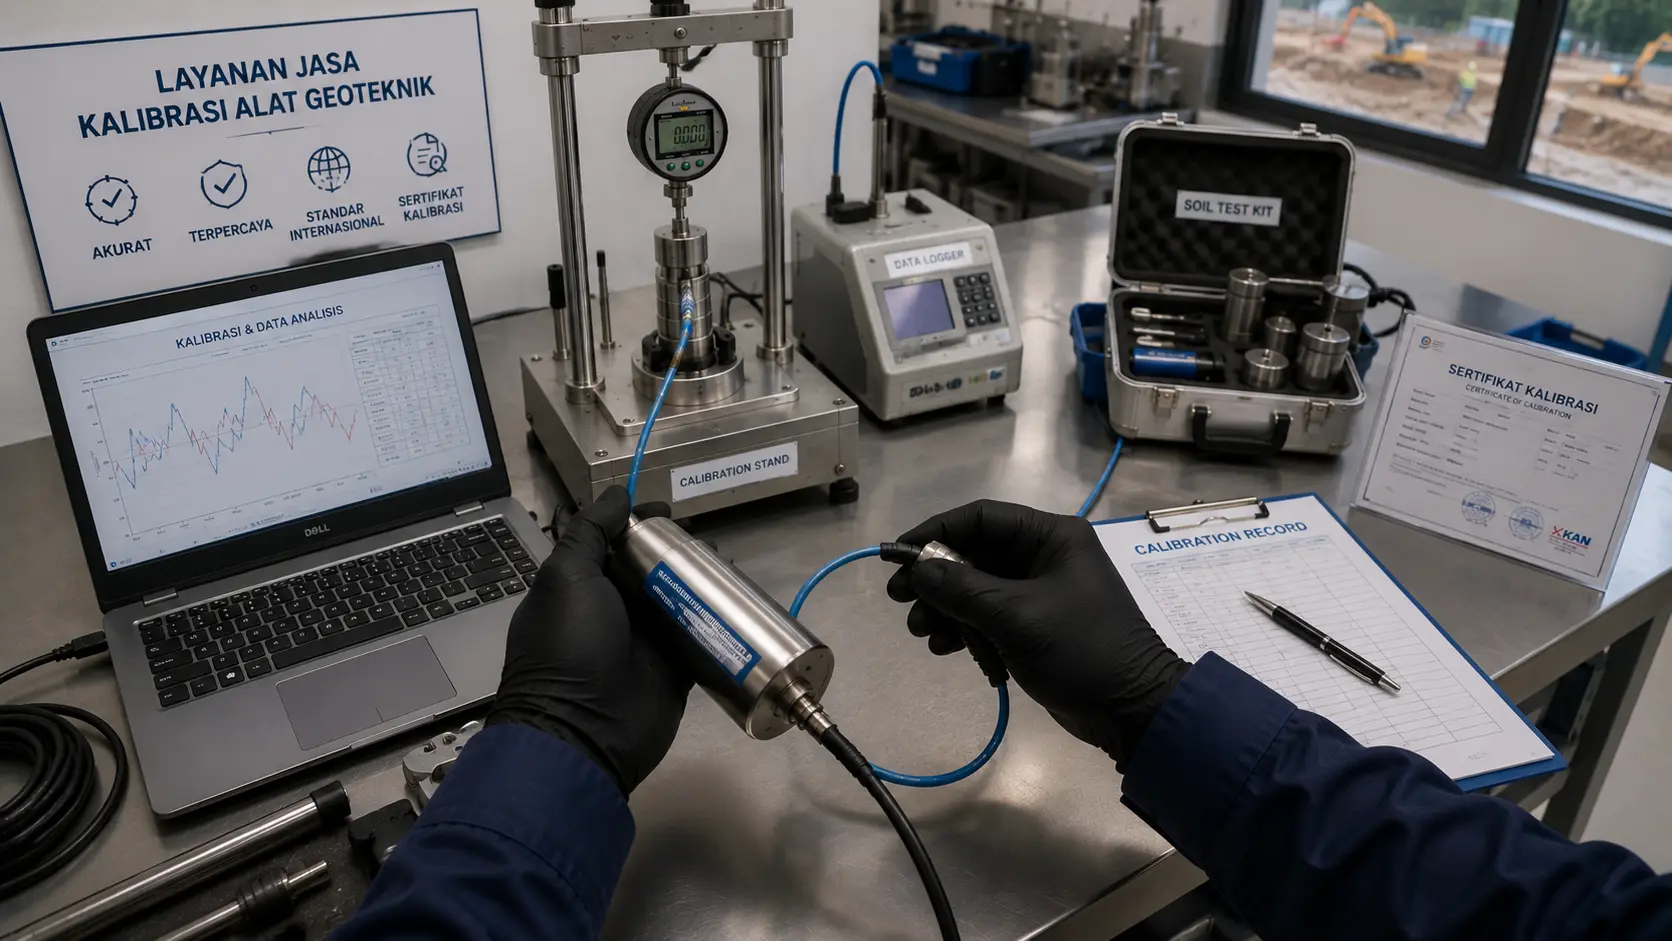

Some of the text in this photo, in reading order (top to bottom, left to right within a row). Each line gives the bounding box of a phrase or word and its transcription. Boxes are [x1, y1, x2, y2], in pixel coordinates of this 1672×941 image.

[155, 51, 360, 93] LAYANAN JASA
[78, 75, 435, 139] KALIBRASI ALAT GEOTEKNIK
[398, 187, 463, 206] SERTIFIKAT
[306, 203, 364, 222] STANDAR
[403, 203, 463, 221] KALIBRASI
[1184, 199, 1274, 218] SOIL TEST KIT
[189, 218, 273, 242] TERPERCAYA
[290, 216, 384, 241] INTERNASIONAL
[92, 238, 151, 259] AKURAT
[894, 250, 964, 270] DATA LOGGER
[176, 327, 241, 349] KALIBRASI
[245, 324, 254, 335] &
[256, 316, 289, 332] DATA
[291, 305, 343, 325] ANALISIS
[1449, 363, 1599, 415] SERTIFIKAT KALIBRASI
[1465, 384, 1512, 404] CERTIFICATE
[680, 454, 790, 487] CALIBRATION STAND
[304, 524, 331, 537] DELL
[1134, 534, 1241, 556] CALIBRATION
[1247, 522, 1308, 540] RECORD
